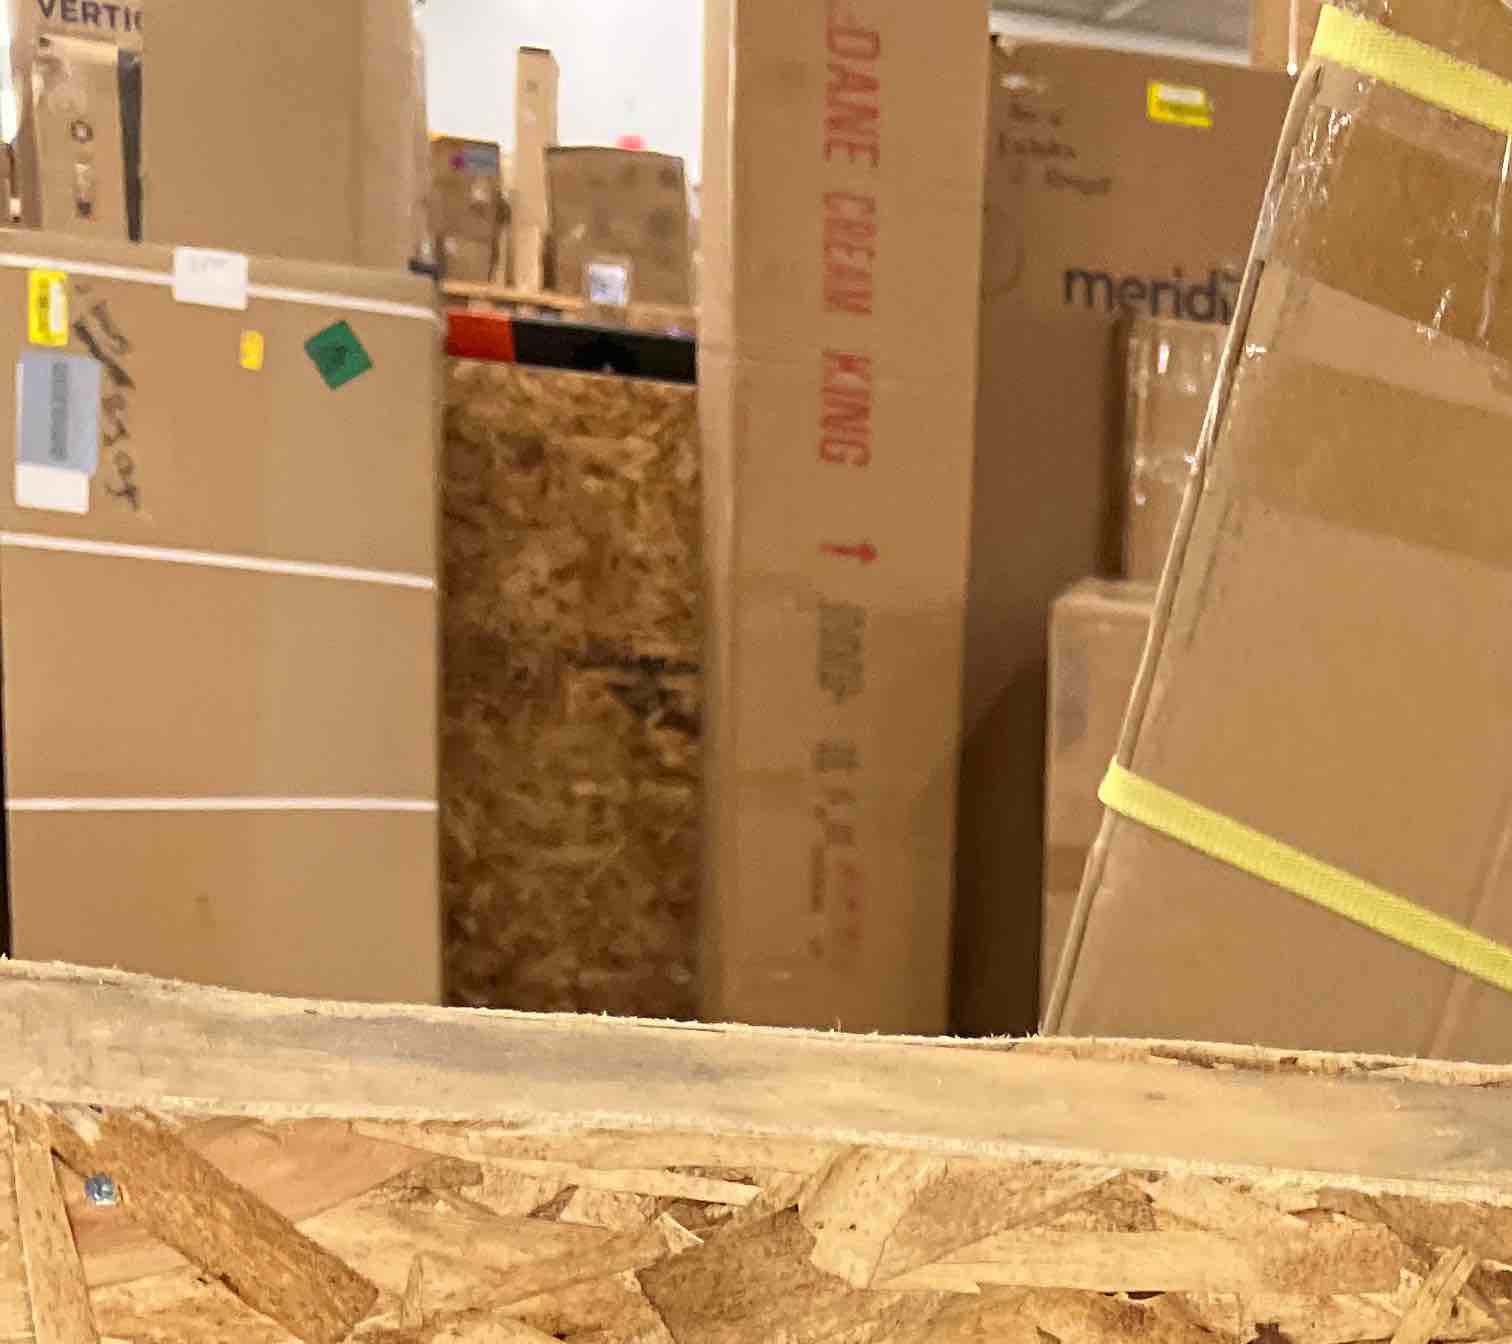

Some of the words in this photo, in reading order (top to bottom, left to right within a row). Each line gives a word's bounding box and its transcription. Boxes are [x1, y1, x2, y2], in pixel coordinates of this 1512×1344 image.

[823, 2, 881, 168] DANE
[1064, 265, 1235, 325] merid
[819, 349, 873, 468] KING
